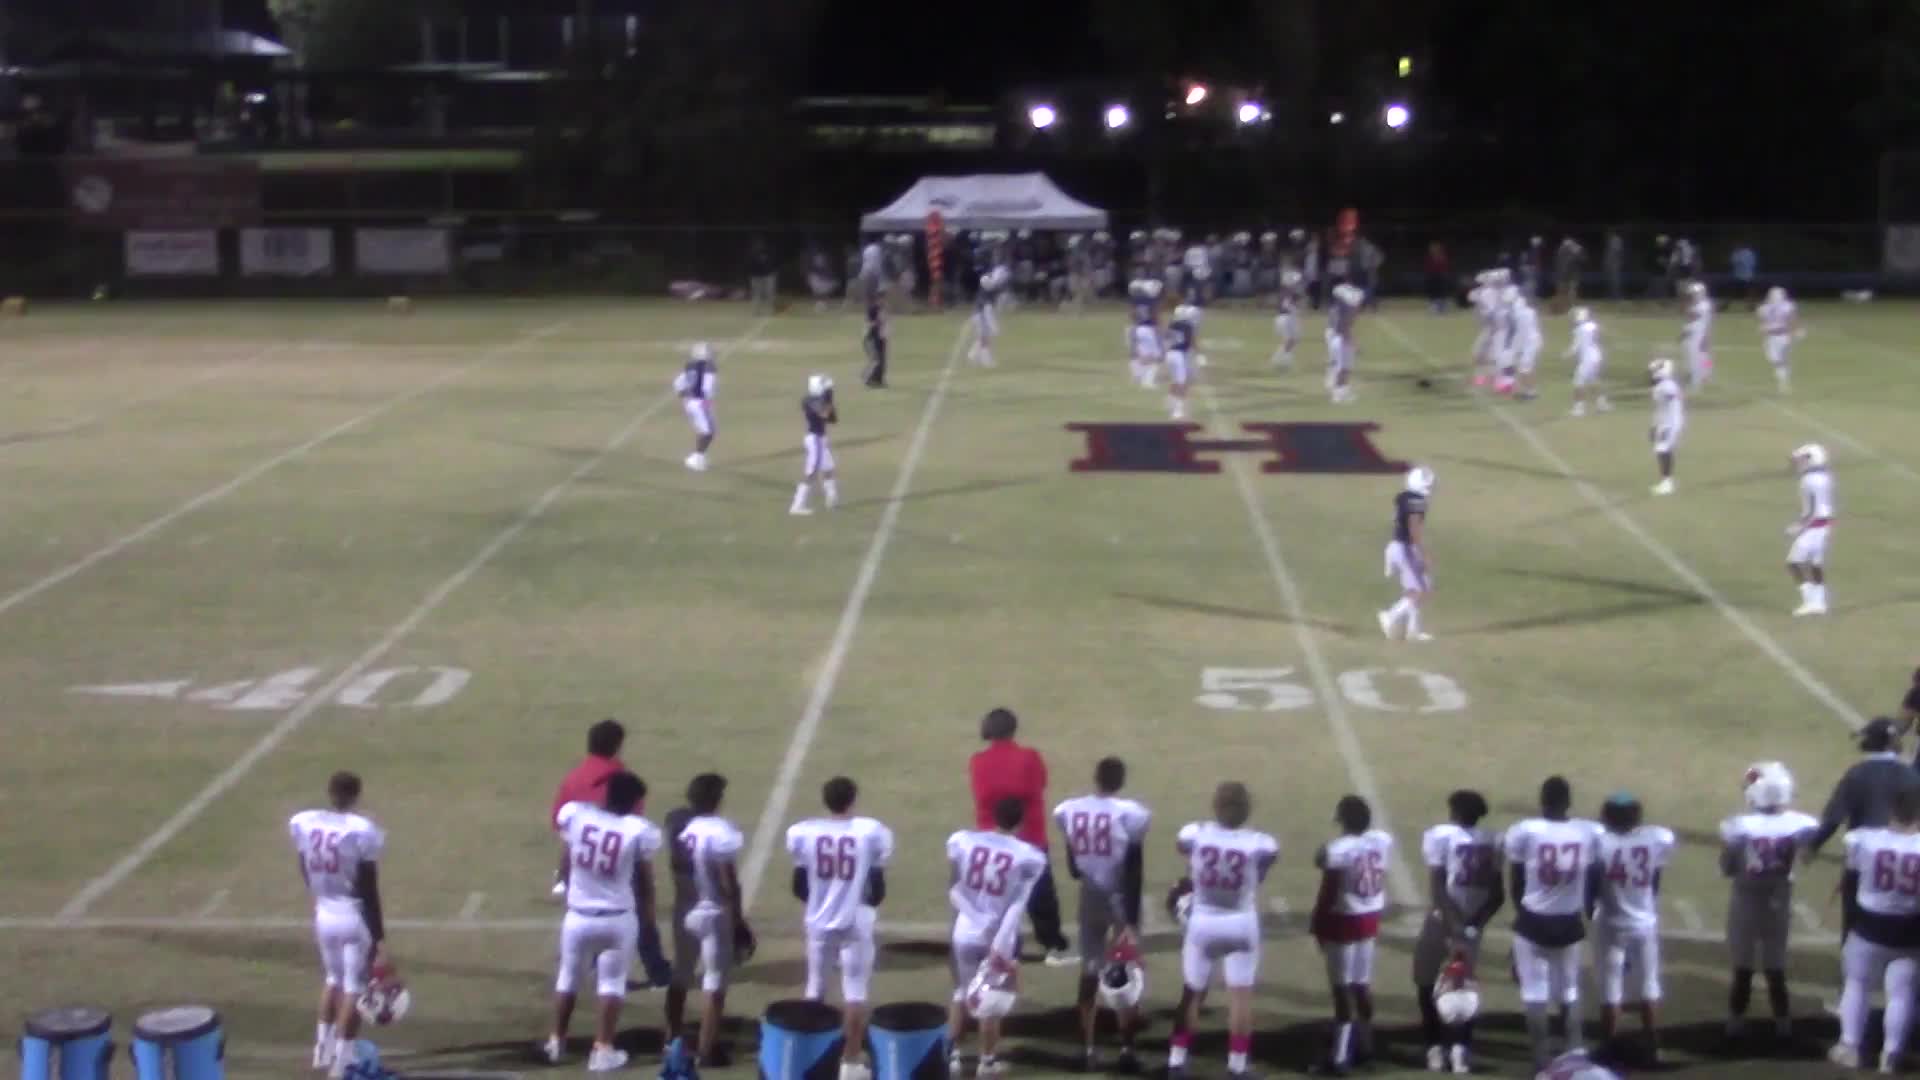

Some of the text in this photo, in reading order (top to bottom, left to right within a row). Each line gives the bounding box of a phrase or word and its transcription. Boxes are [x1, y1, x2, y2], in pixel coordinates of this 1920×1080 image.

[186, 665, 472, 710] 40
[1192, 667, 1466, 711] 50
[309, 828, 340, 874] 35
[577, 824, 622, 877] 59
[1072, 811, 1113, 857] 88
[816, 836, 856, 880] 66
[966, 846, 1013, 896] 83
[1200, 846, 1245, 890] 33
[1538, 842, 1582, 887] 87
[1605, 846, 1650, 888] 43
[1874, 848, 1920, 895] 69
